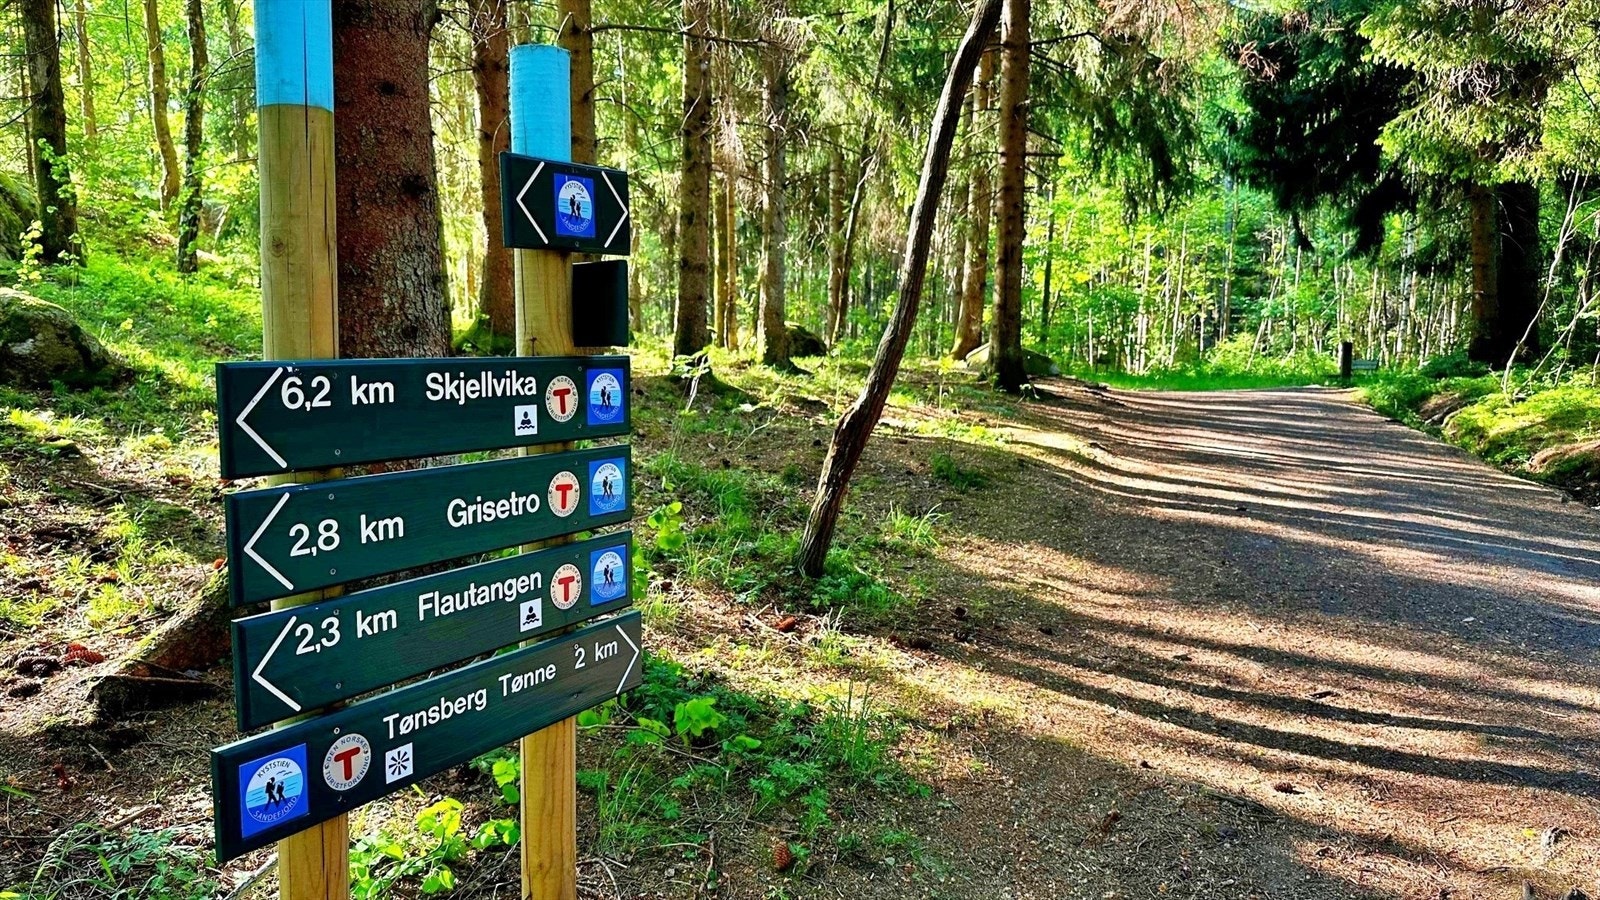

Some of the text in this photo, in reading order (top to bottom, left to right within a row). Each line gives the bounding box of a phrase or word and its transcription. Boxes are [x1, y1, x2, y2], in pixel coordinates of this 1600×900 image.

[280, 370, 537, 411] 6,2 km Skjellvika
[553, 388, 571, 415] T
[555, 484, 573, 510] T
[289, 491, 540, 557] 2,8 km Grisetro
[558, 576, 575, 602] T
[295, 571, 542, 655] 2,3 km Flautangen
[383, 638, 618, 740] Tønsberg Tønne 2 km
[327, 736, 367, 762] DEN NORSKE
[334, 746, 361, 781] T
[257, 760, 291, 778] KYSTSTIEN
[325, 755, 370, 789] TURISTFORENING
[253, 796, 298, 821] SANDEFJORD
